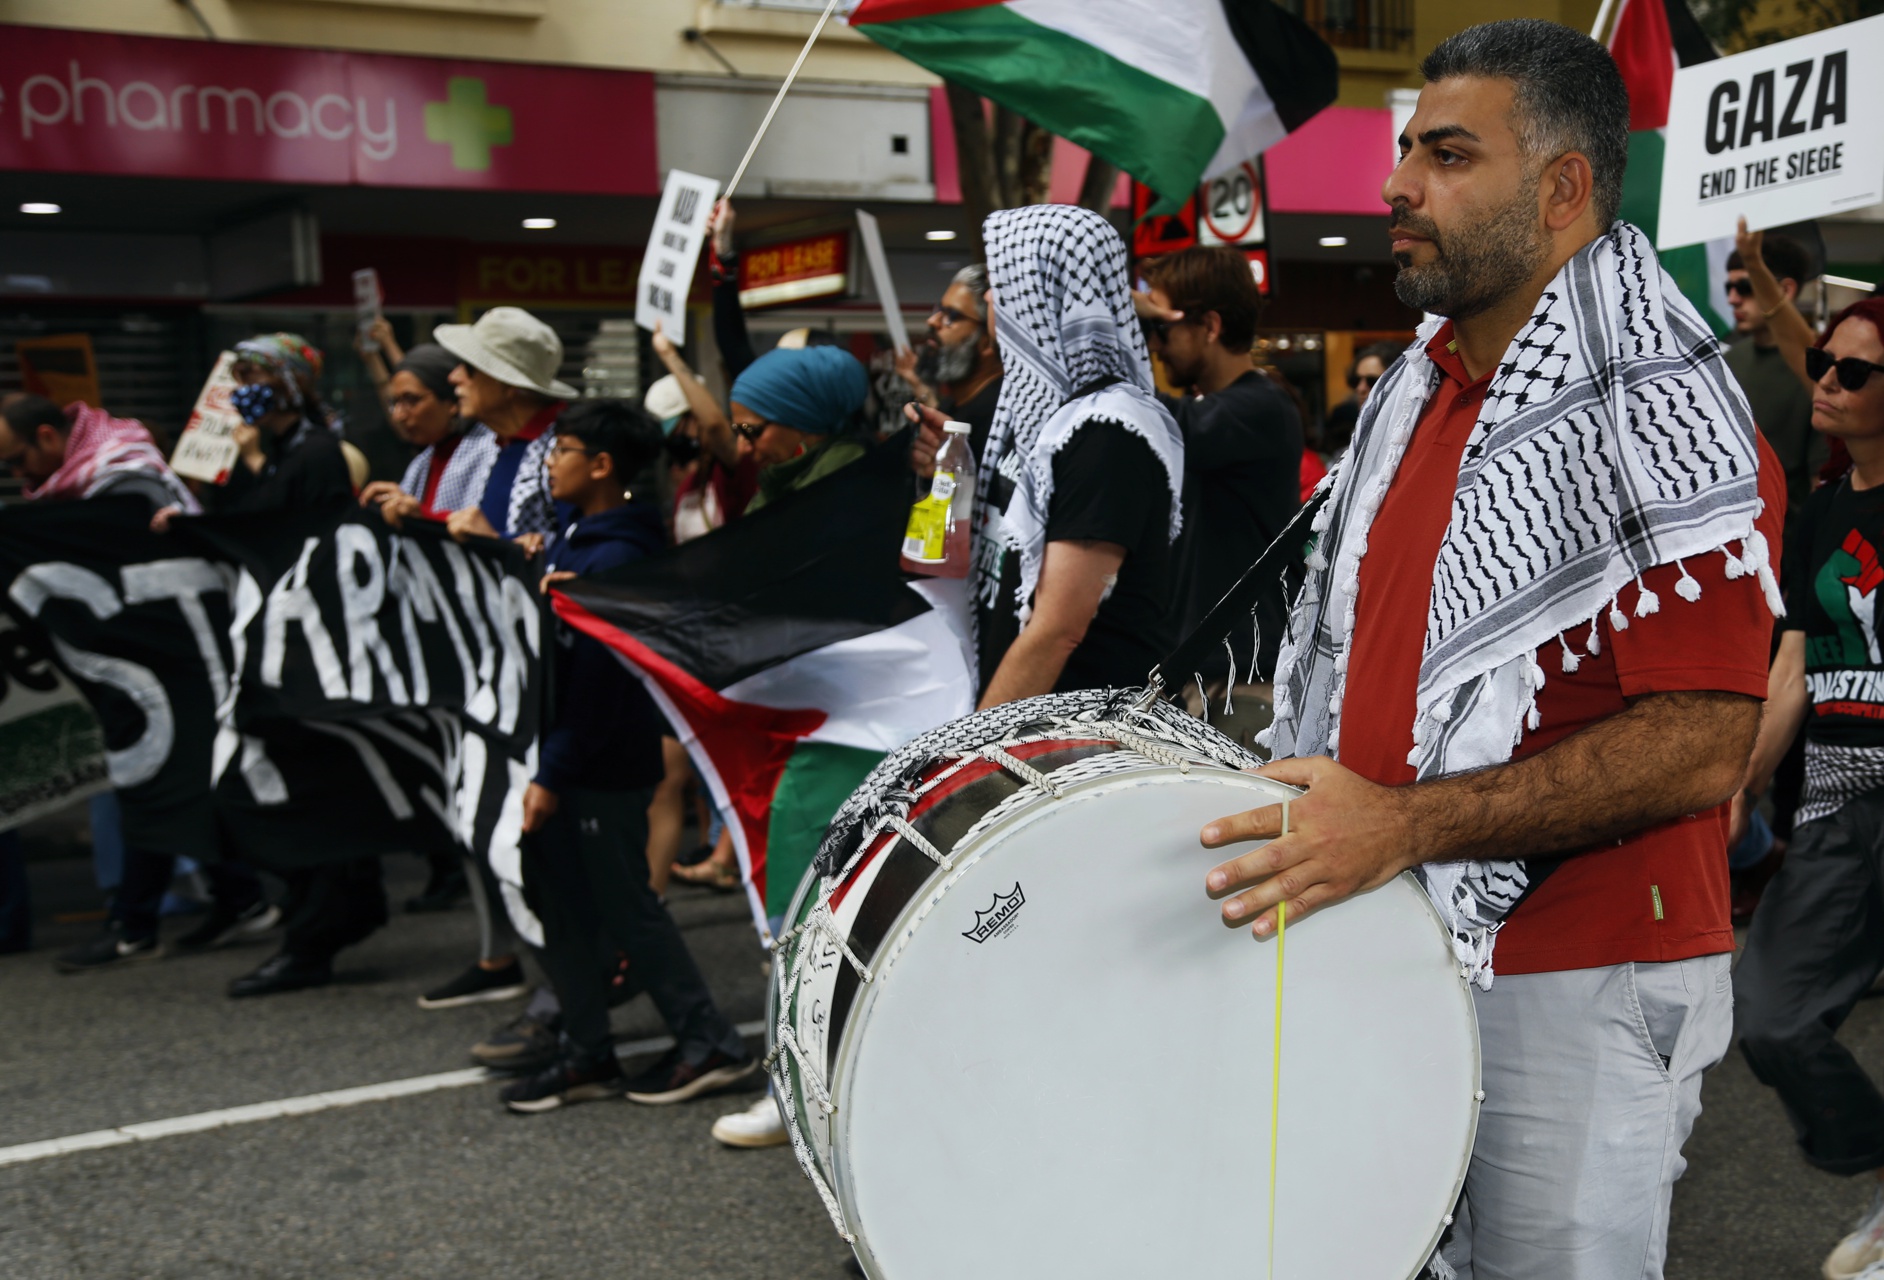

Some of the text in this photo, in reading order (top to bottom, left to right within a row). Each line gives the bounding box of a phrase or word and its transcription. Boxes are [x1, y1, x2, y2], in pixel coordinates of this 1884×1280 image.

[20, 60, 397, 161] pharmacy
[1705, 49, 1848, 155] GAZA
[1213, 174, 1250, 218] 20
[1699, 142, 1844, 200] END THE SIEGE
[478, 255, 566, 293] FOR
[976, 896, 1020, 938] REMO
